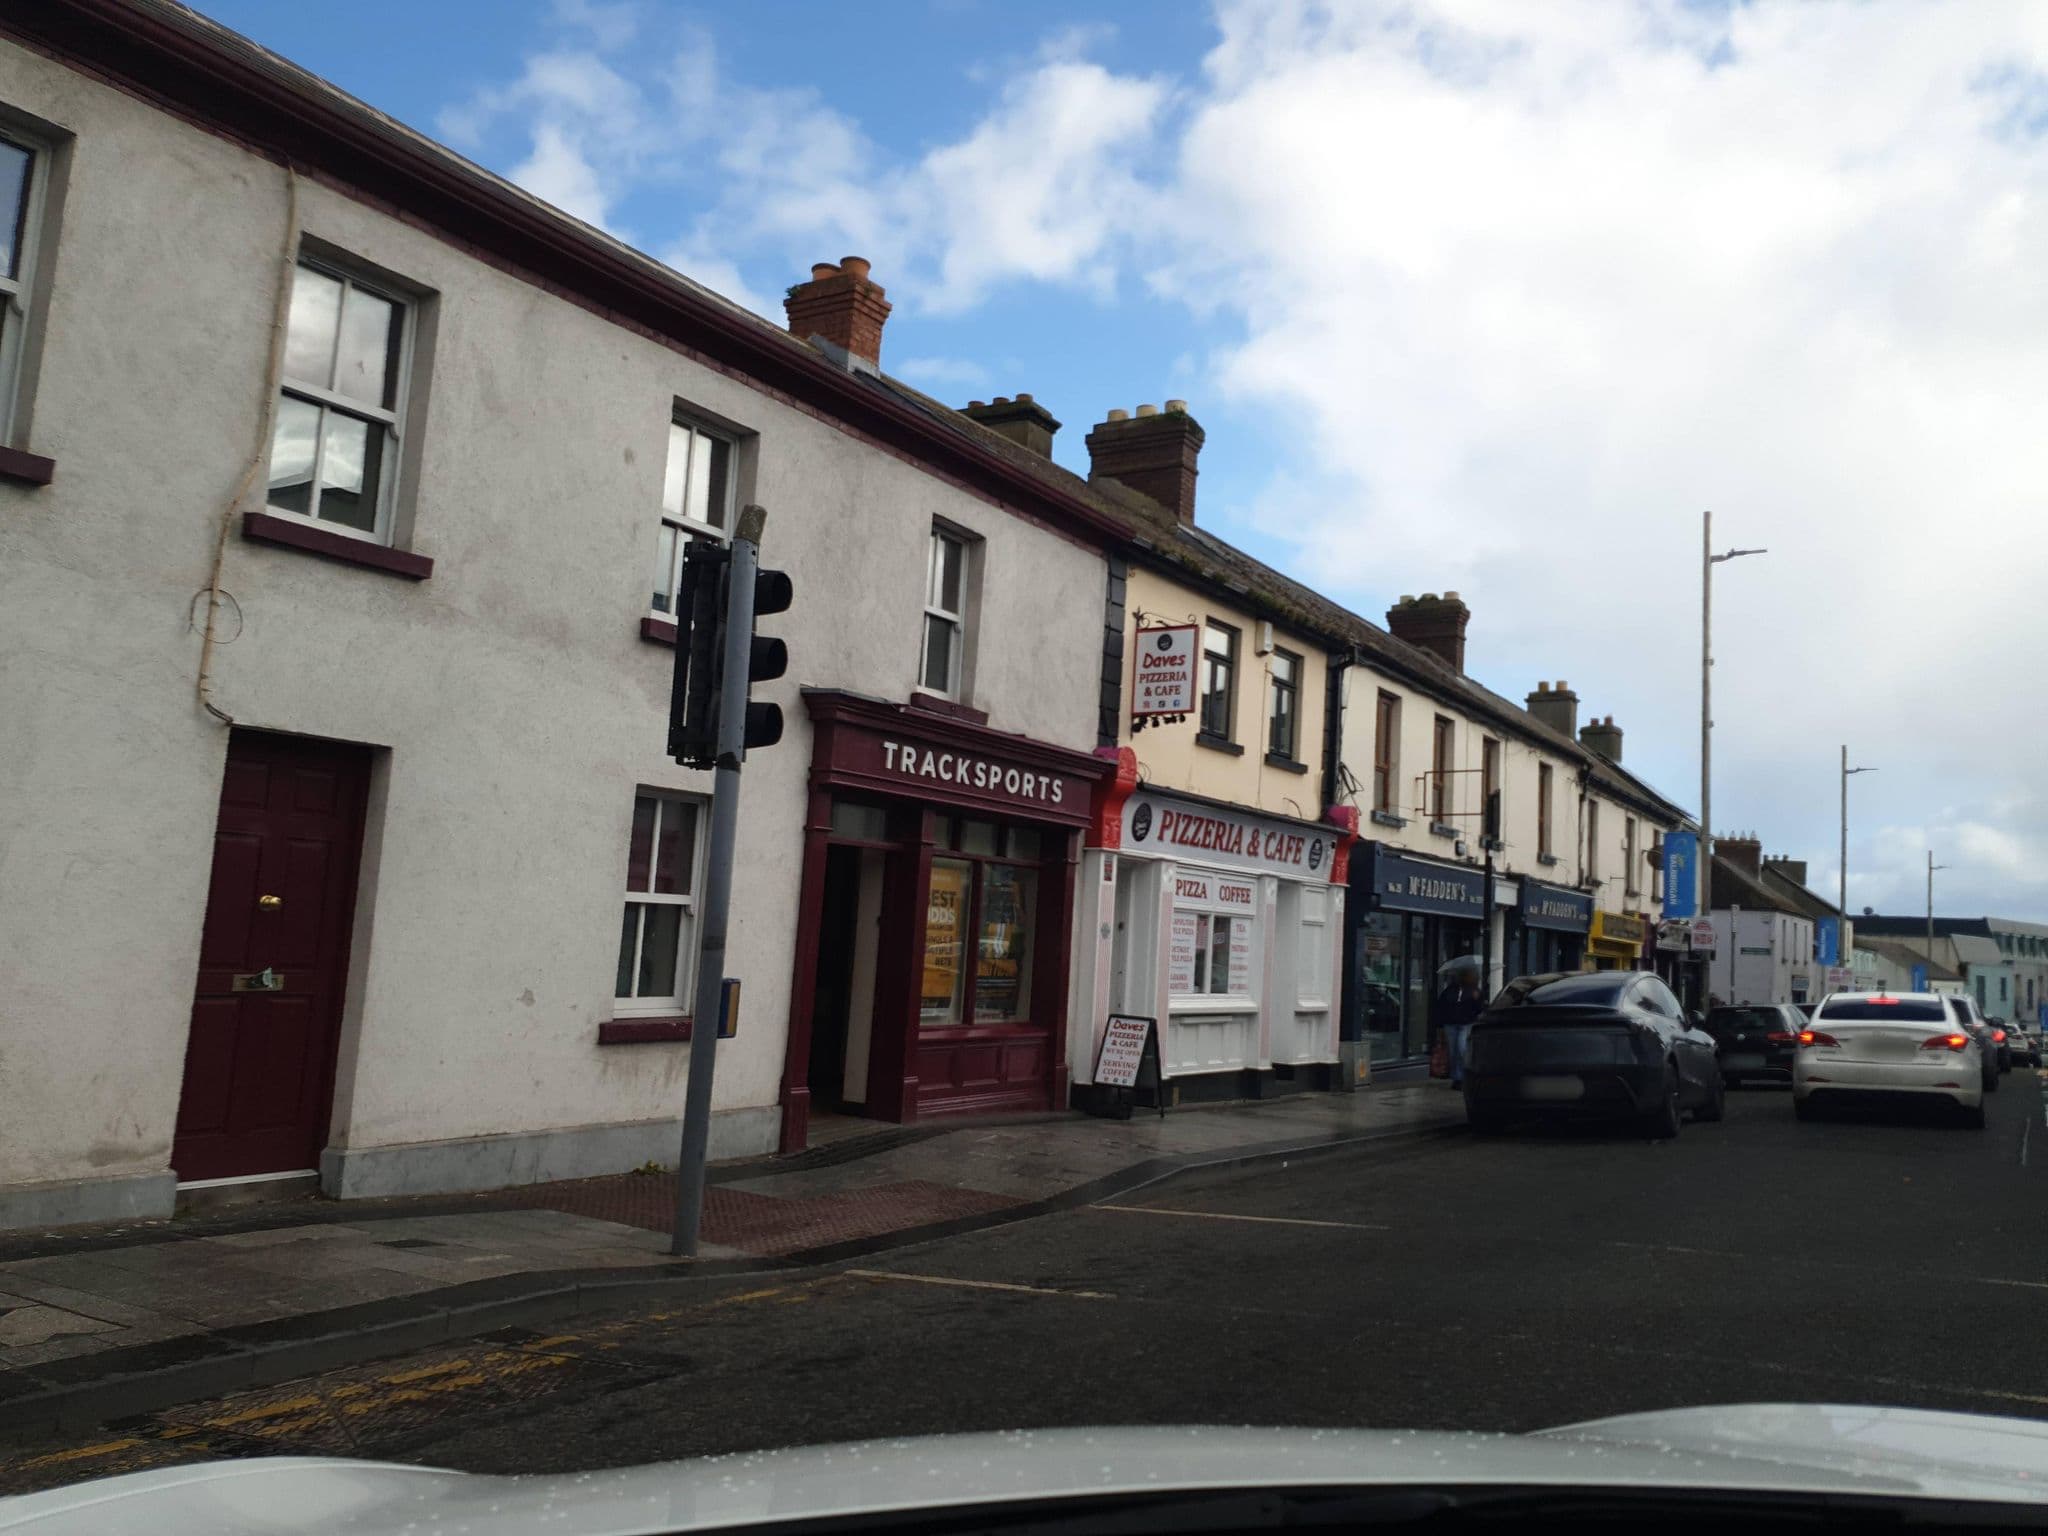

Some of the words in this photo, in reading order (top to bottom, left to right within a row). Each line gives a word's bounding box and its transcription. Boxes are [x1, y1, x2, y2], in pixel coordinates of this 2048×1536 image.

[1143, 653, 1186, 669] Daves
[1139, 672, 1187, 683] PIZZERIA
[1144, 687, 1152, 697] &
[1154, 685, 1181, 696] CAFE
[883, 741, 1063, 803] TRACKSPORTS
[1157, 809, 1243, 855] PIZZERIA
[1246, 828, 1260, 857] &
[1263, 830, 1305, 865] CAFE
[1175, 879, 1207, 899] PIZZA
[1219, 885, 1251, 904] COFFEE
[1113, 1019, 1146, 1031] Daves
[1109, 1031, 1144, 1040] PIZZERIA
[1119, 1040, 1138, 1048] CAFE
[1103, 1060, 1136, 1070] SERVING
[1103, 1068, 1133, 1077] COFFEE
